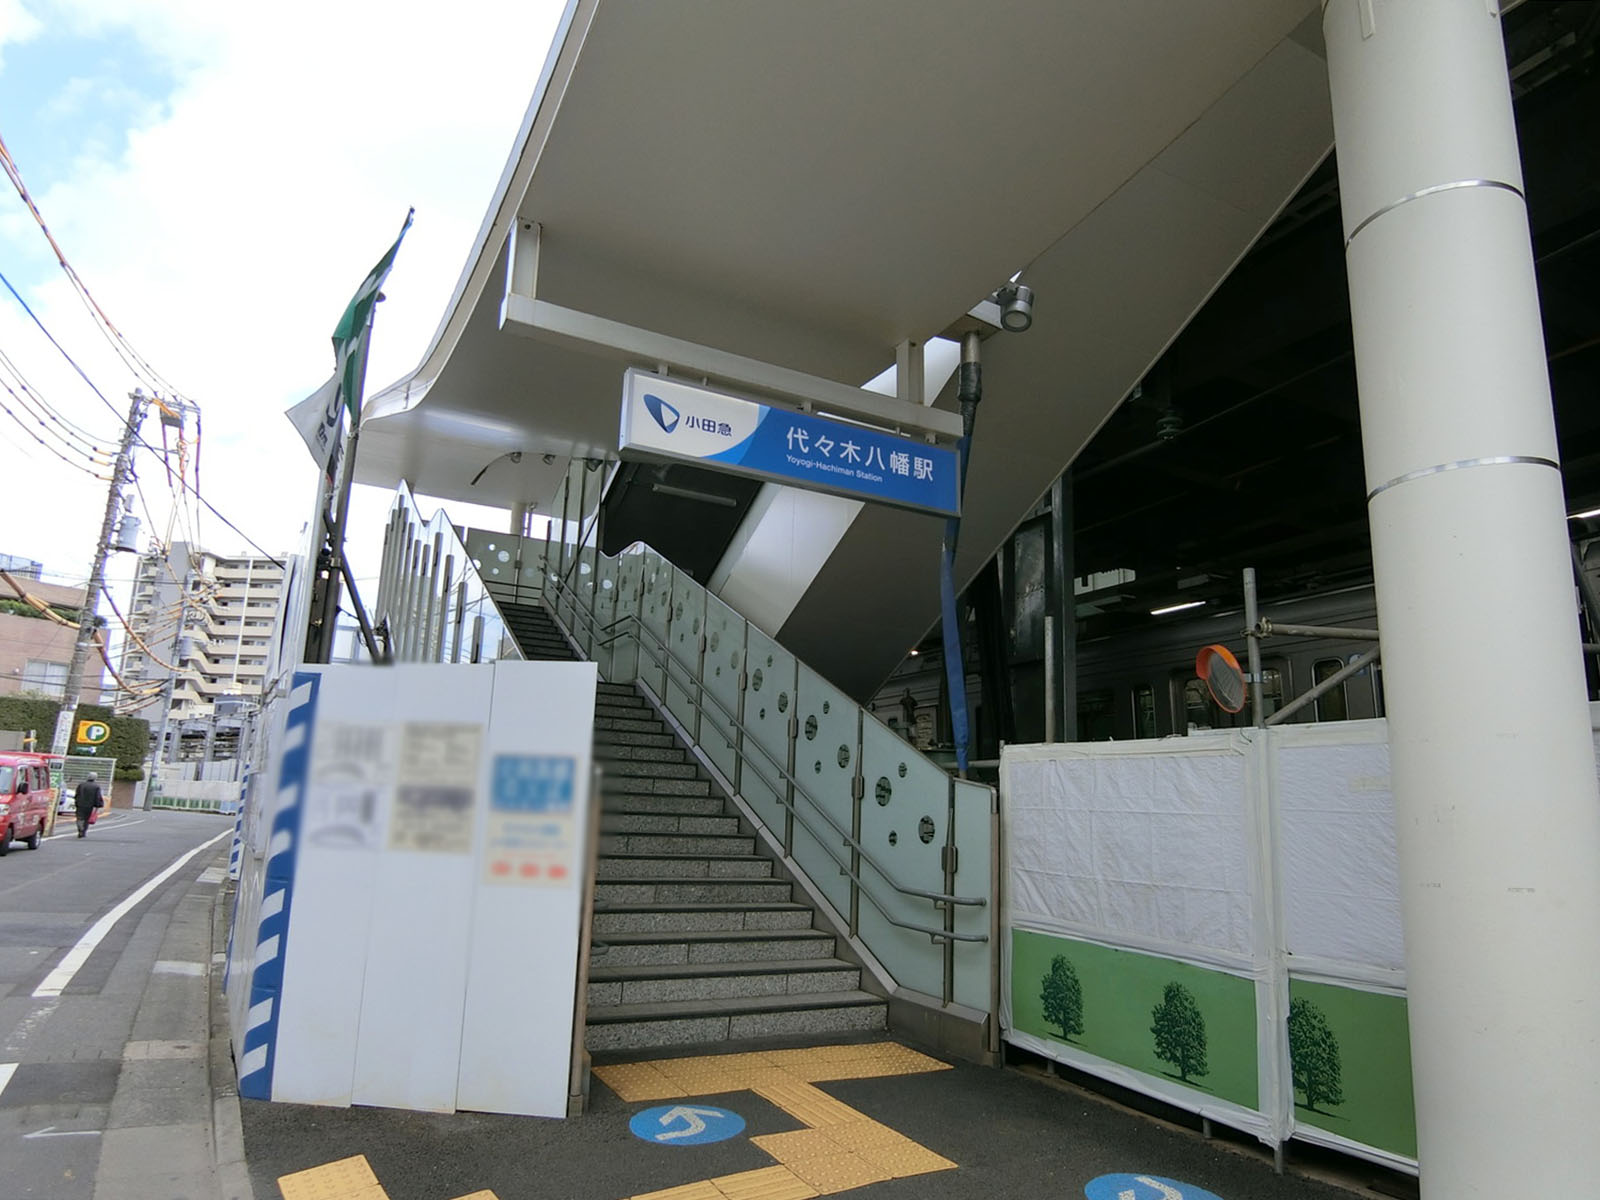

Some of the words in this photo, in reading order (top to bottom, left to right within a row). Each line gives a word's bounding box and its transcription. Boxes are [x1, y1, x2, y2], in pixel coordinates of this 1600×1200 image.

[685, 415, 732, 437] 小田急
[786, 426, 934, 481] 代々木八幡駅
[786, 454, 855, 477] Yoyogi-Hachiman
[855, 469, 883, 483] Station
[90, 725, 105, 740] P
